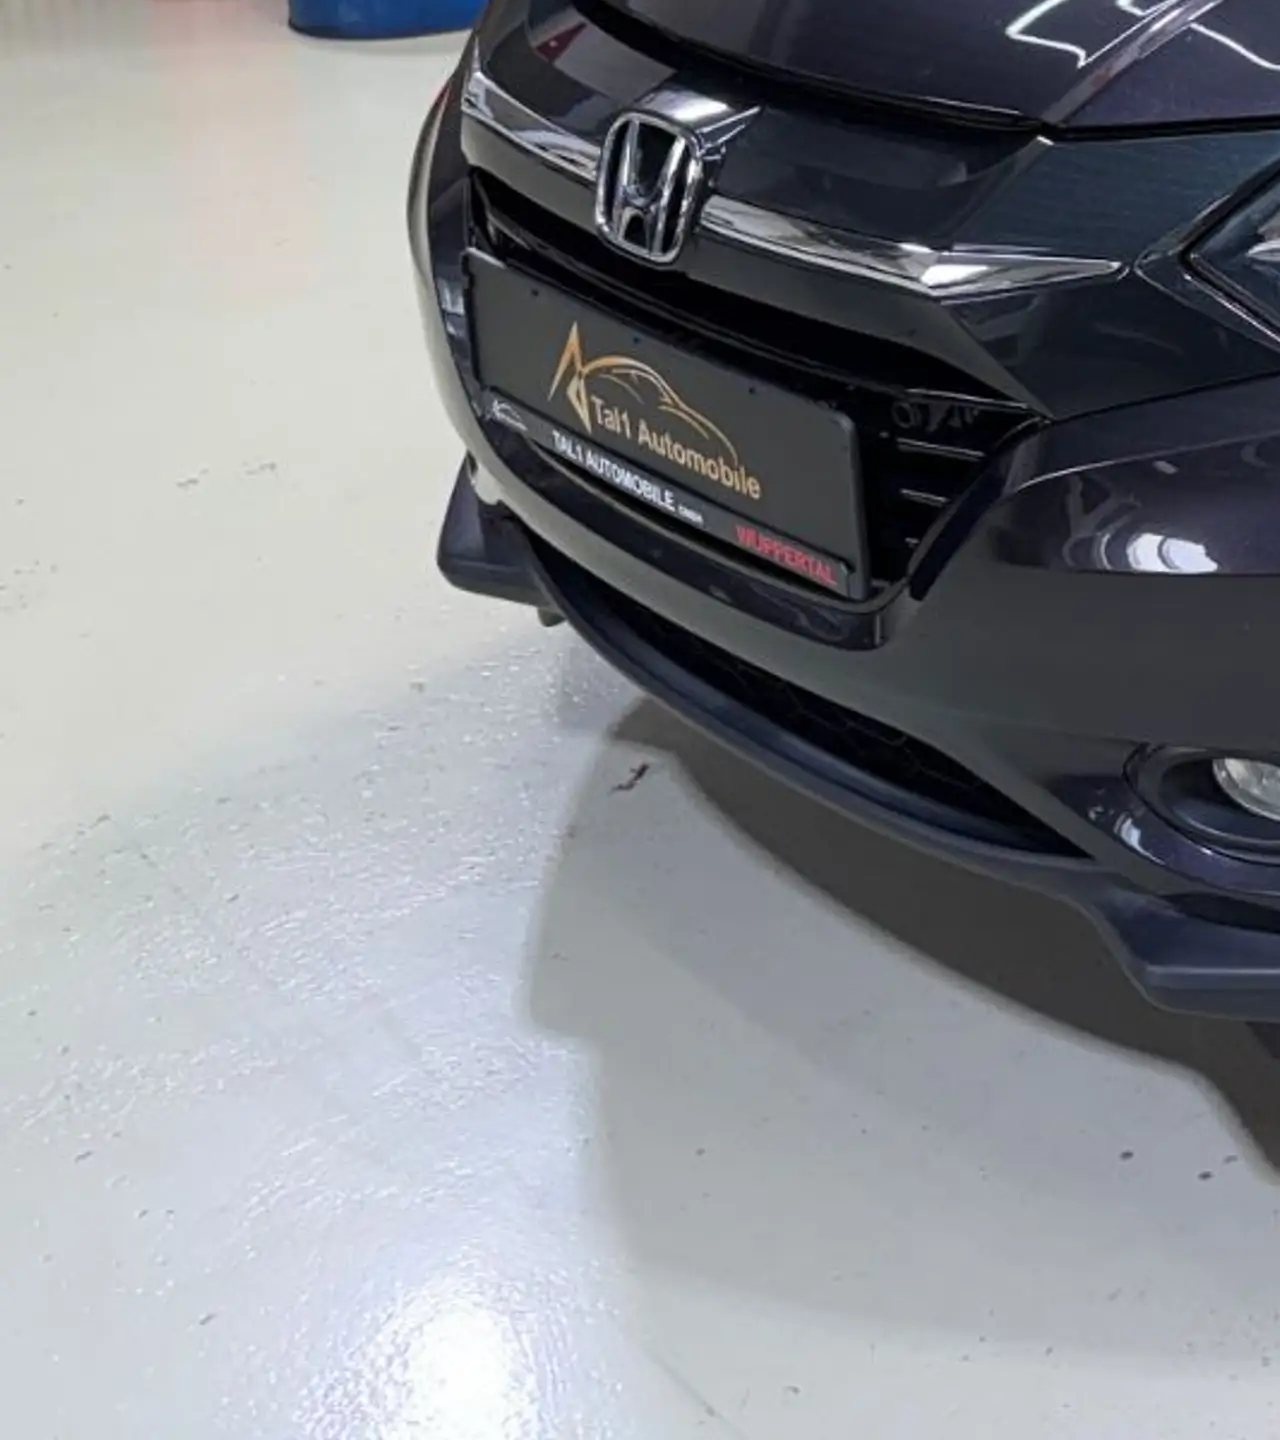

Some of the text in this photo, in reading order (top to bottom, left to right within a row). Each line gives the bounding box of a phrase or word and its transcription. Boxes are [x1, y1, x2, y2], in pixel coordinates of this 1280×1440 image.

[590, 395, 762, 500] Tal1 Automobile
[585, 449, 676, 512] AUTOMOBILE
[735, 524, 838, 586] WUPPERTAL
